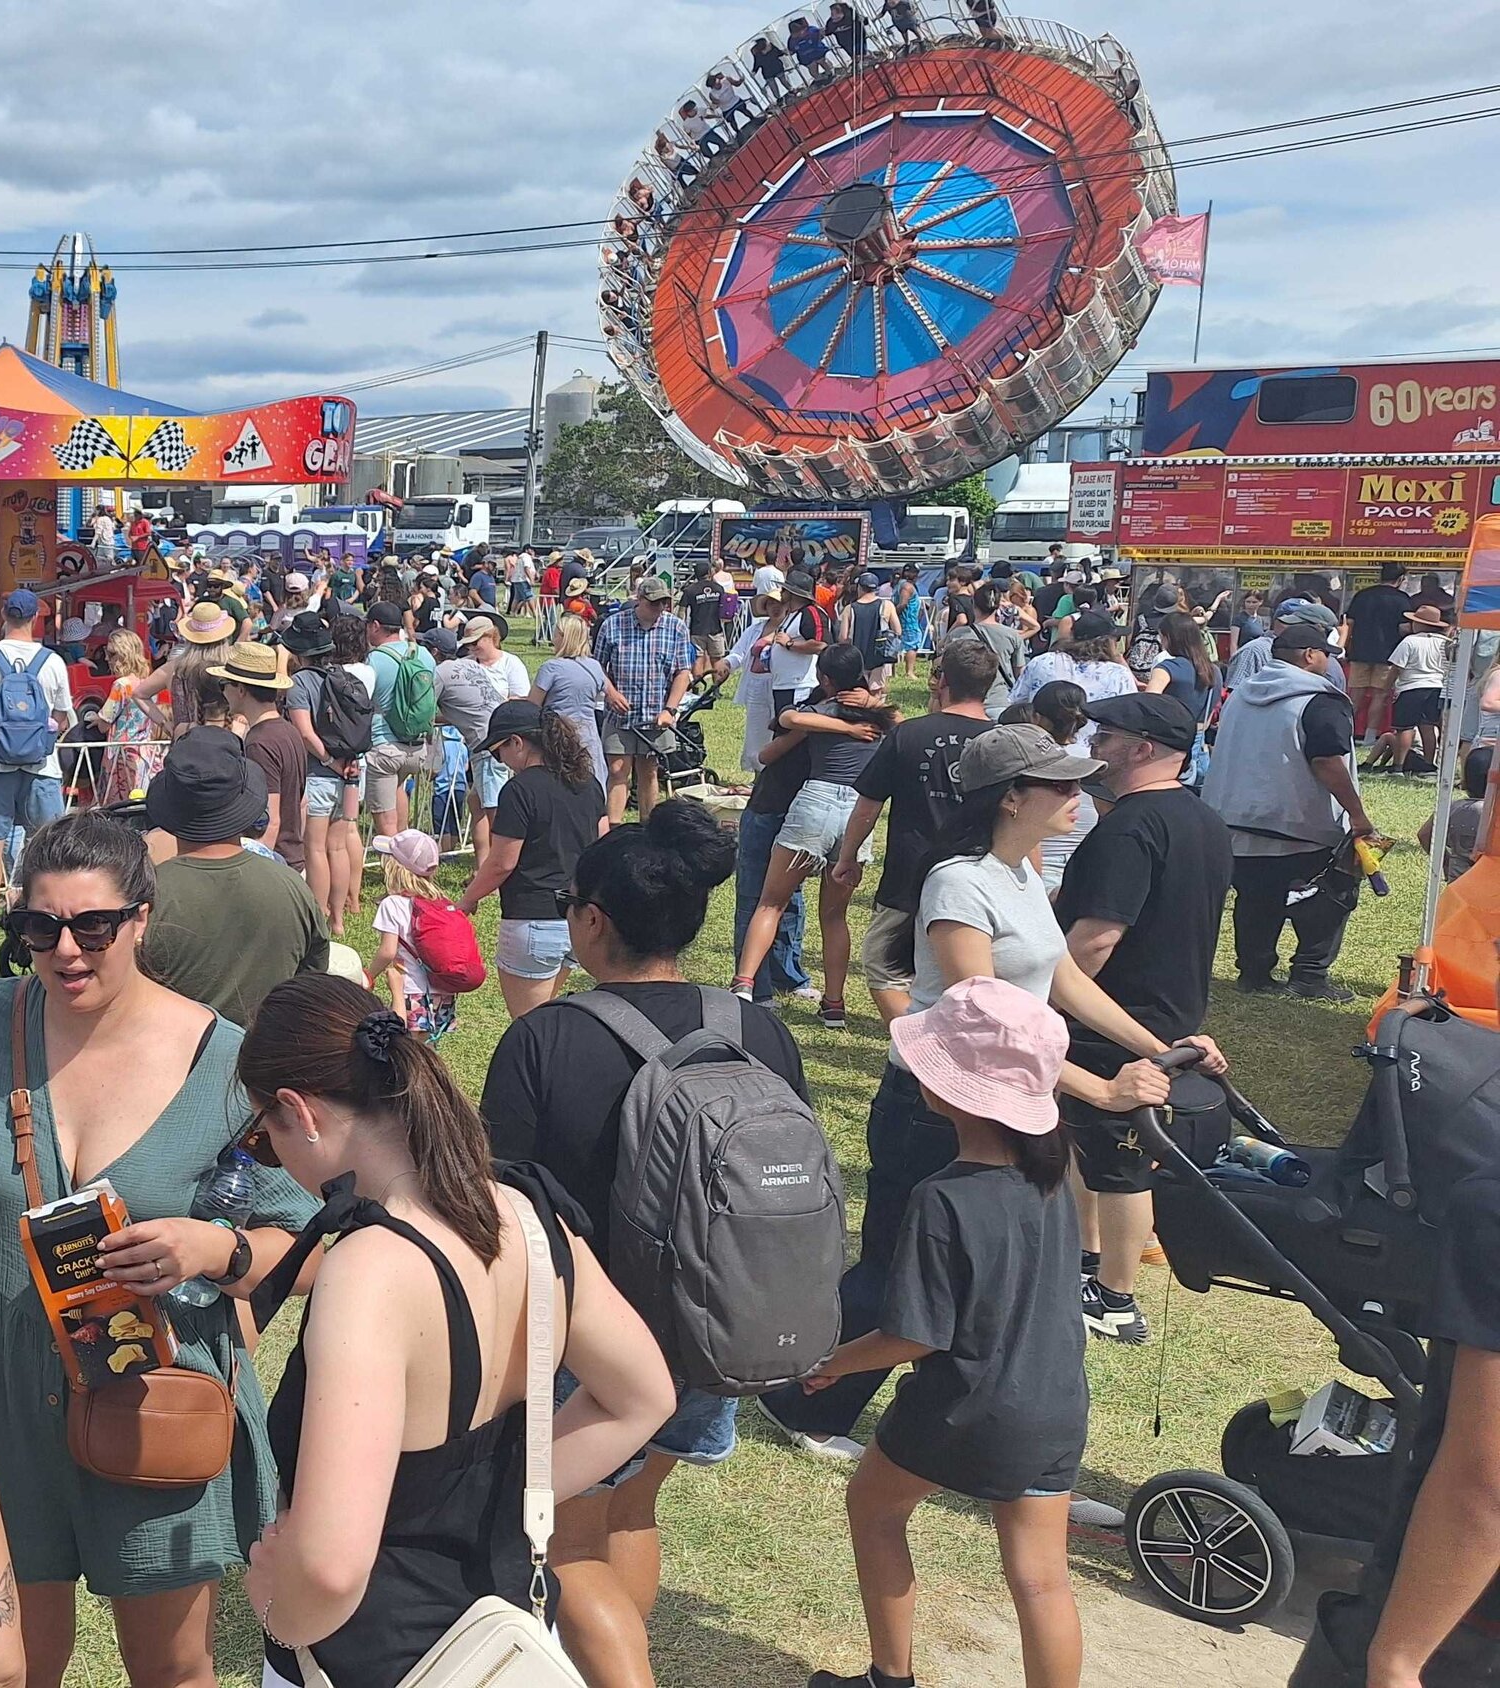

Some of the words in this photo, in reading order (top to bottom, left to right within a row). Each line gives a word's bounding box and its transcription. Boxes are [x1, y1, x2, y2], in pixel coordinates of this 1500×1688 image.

[1369, 379, 1422, 427] 60
[1077, 475, 1096, 484] PLEASE
[1097, 474, 1112, 483] NOTE
[1357, 471, 1467, 504] Maxi
[1074, 489, 1096, 498] COUPONS
[1096, 489, 1111, 497] CAN'T
[1084, 500, 1097, 508] USED
[1097, 499, 1107, 507] FOR
[1079, 510, 1095, 518] GAMES
[1097, 509, 1105, 518] OR
[1363, 505, 1433, 518] PACK
[1072, 520, 1085, 528] FOOD
[1085, 519, 1111, 528] PURCHASE
[1349, 519, 1372, 527] 165
[405, 532, 433, 540] MAHONS
[1347, 527, 1376, 536] $189
[1410, 1050, 1421, 1092] nuna
[762, 1163, 803, 1174] UNDER
[760, 1175, 810, 1187] ARMOUR
[74, 1266, 98, 1280] CHIPS
[84, 1287, 96, 1297] Soy
[95, 1281, 118, 1292] Chicken
